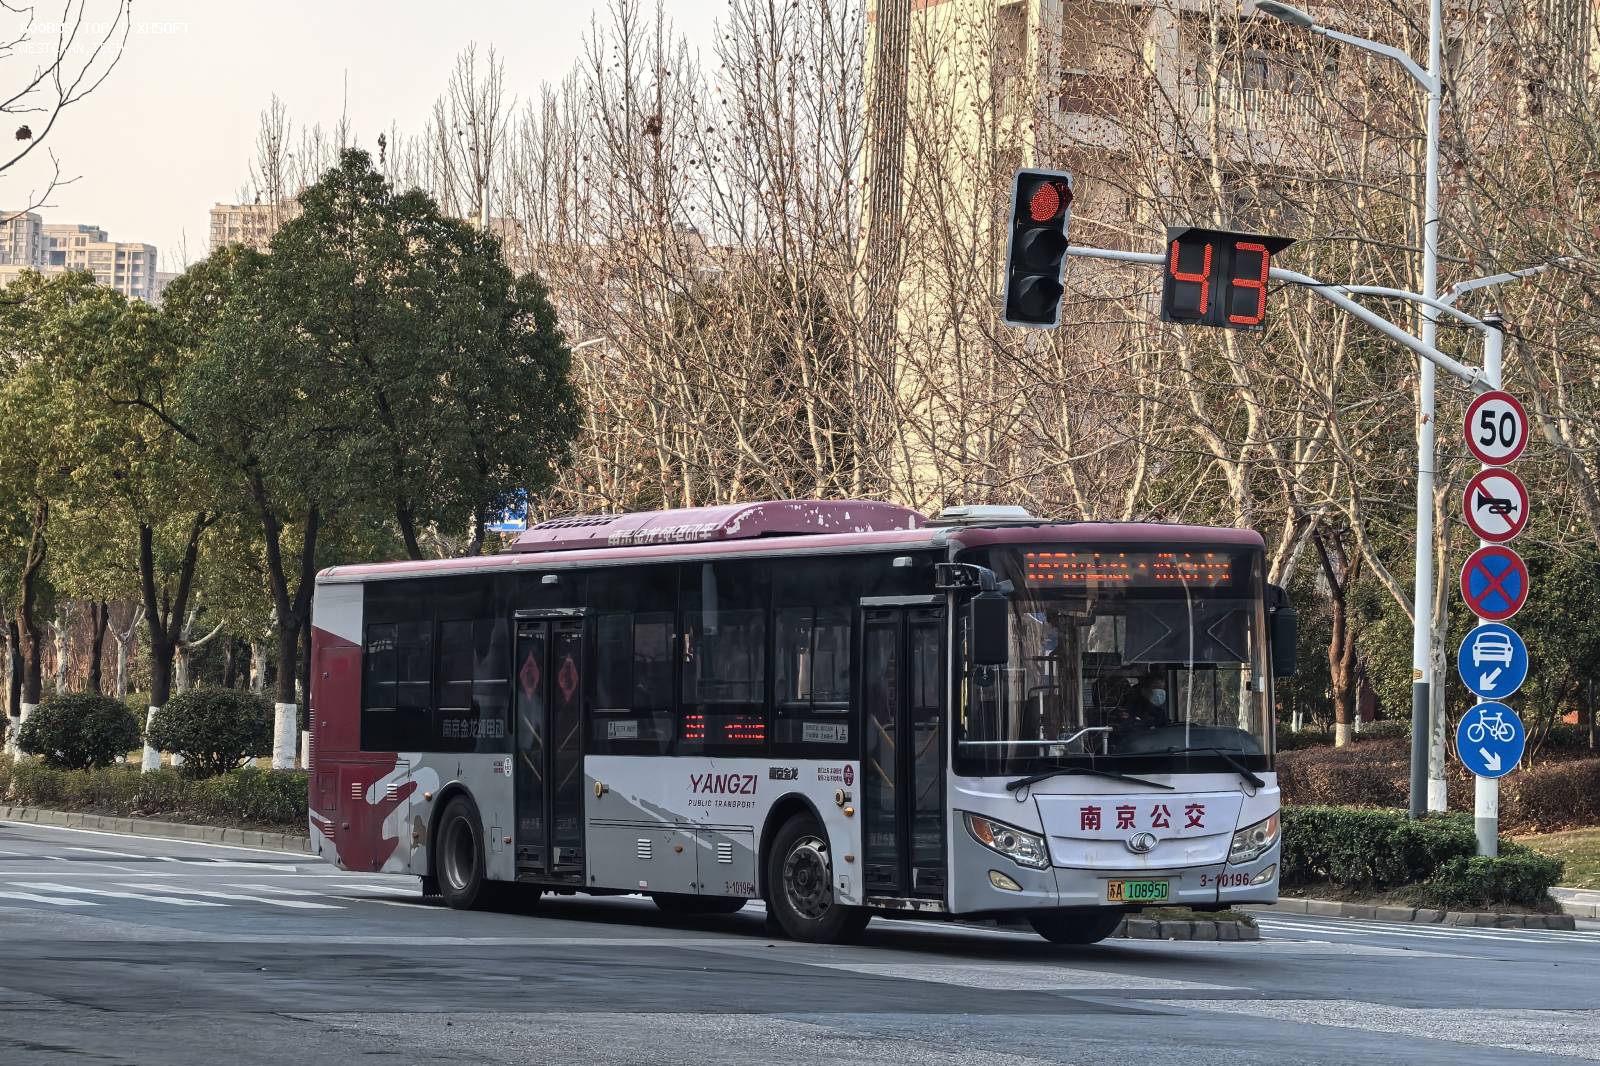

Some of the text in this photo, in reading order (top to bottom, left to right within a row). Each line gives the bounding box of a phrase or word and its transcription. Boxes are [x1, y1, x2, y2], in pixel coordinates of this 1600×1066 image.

[1170, 240, 1270, 325] 43
[1480, 410, 1516, 448] 50
[690, 773, 758, 795] YANGZI
[715, 800, 755, 809] TRANSPORT
[1080, 804, 1205, 831] 南京公交
[1200, 873, 1249, 887] 3-10196
